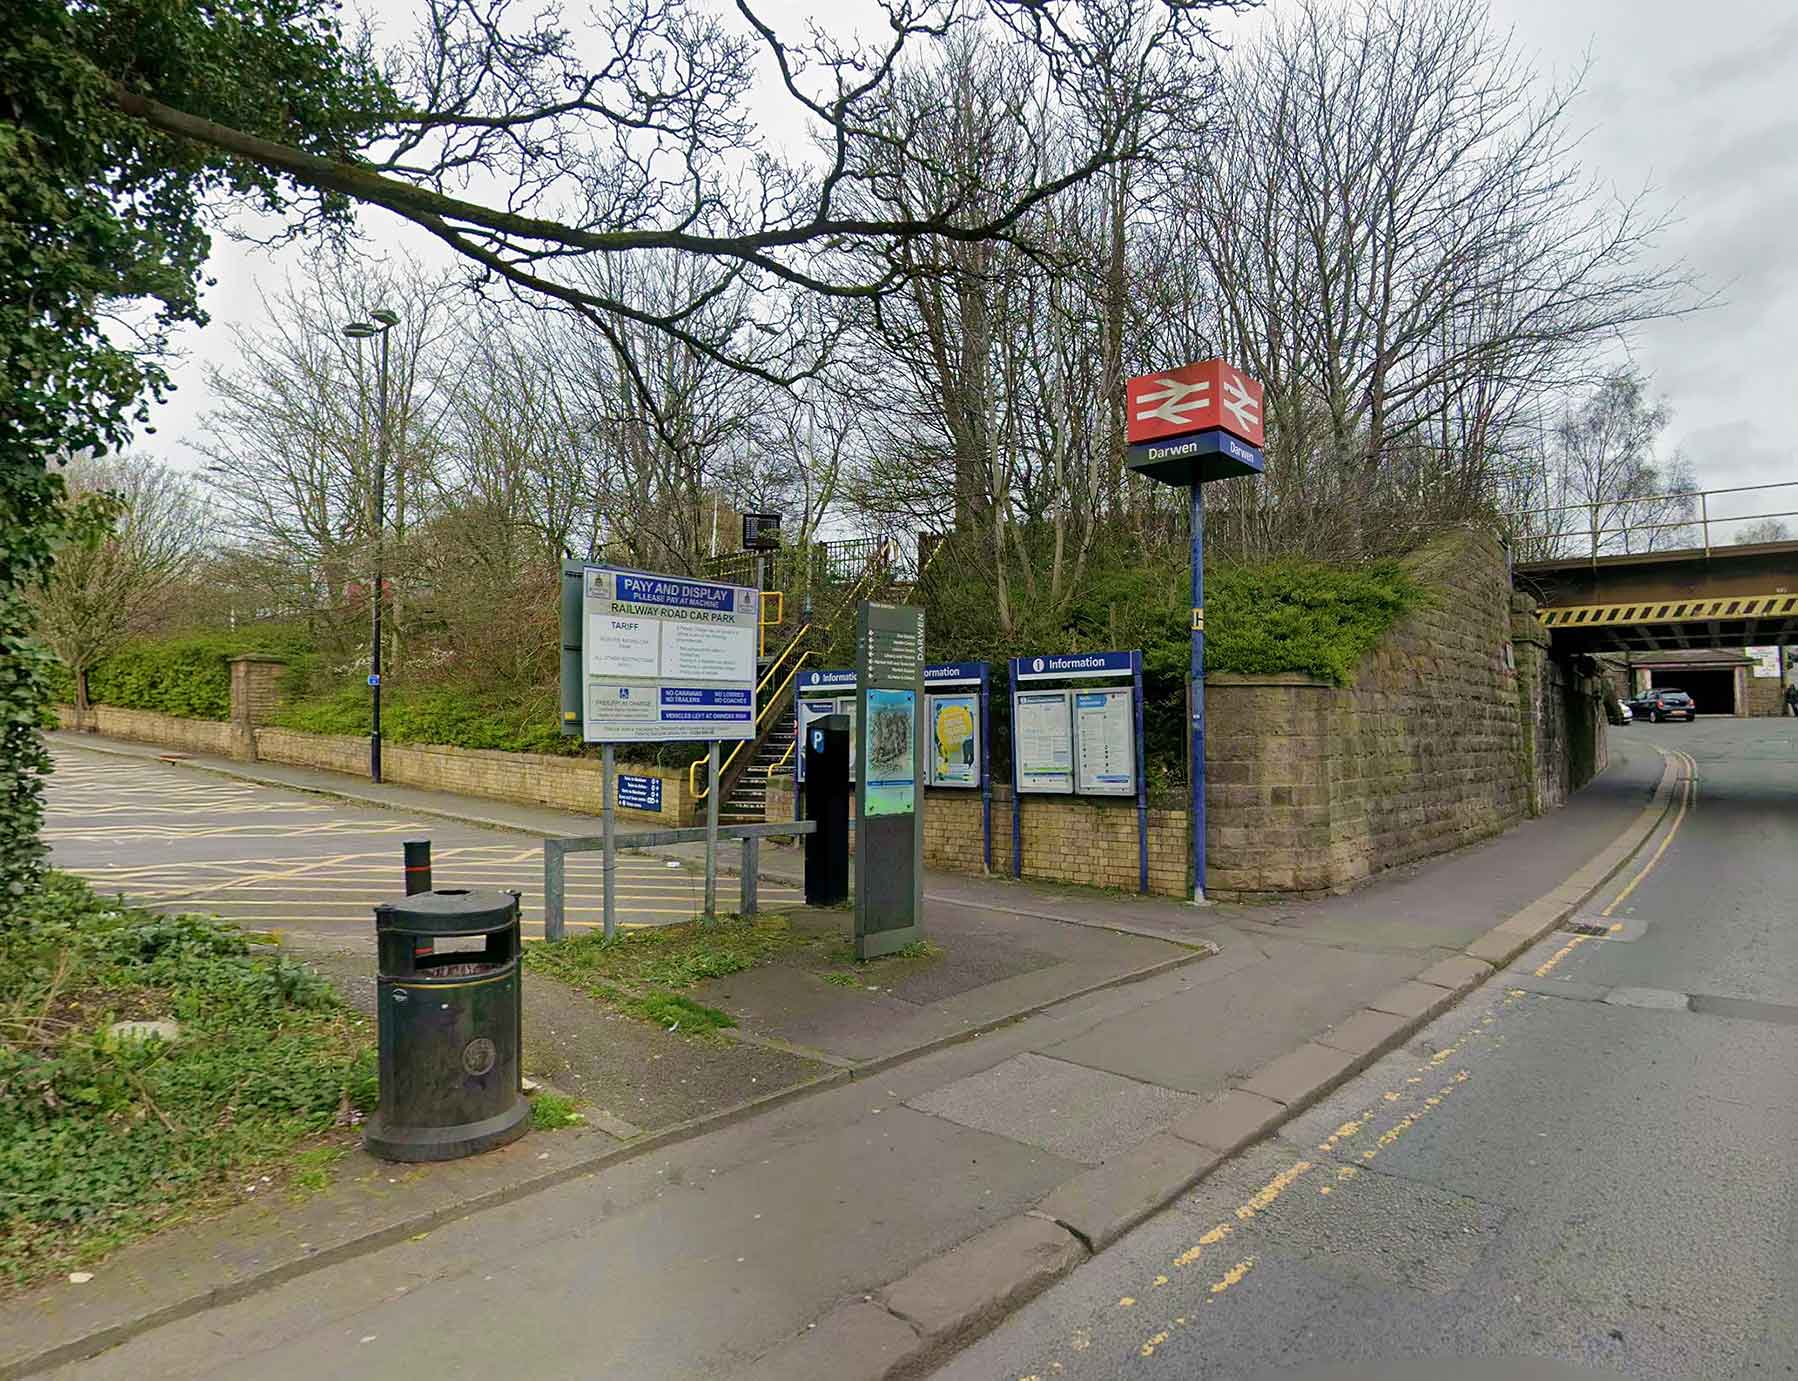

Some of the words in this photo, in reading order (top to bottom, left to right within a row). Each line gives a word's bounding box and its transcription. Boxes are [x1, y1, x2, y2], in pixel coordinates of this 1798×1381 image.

[1148, 442, 1197, 460] Darwen
[1230, 441, 1254, 463] Darwen
[655, 583, 680, 596] AND
[682, 586, 728, 601] DISPLAY
[667, 595, 679, 603] PAY
[611, 603, 659, 616] RAILWAY
[660, 607, 688, 619] ROAD
[690, 611, 709, 621] CAR
[711, 613, 735, 624] PARK
[611, 622, 640, 631] TARIFF
[917, 613, 925, 661] DARWEN
[1049, 656, 1105, 669] Information
[923, 667, 960, 677] ormation
[814, 731, 823, 750] P
